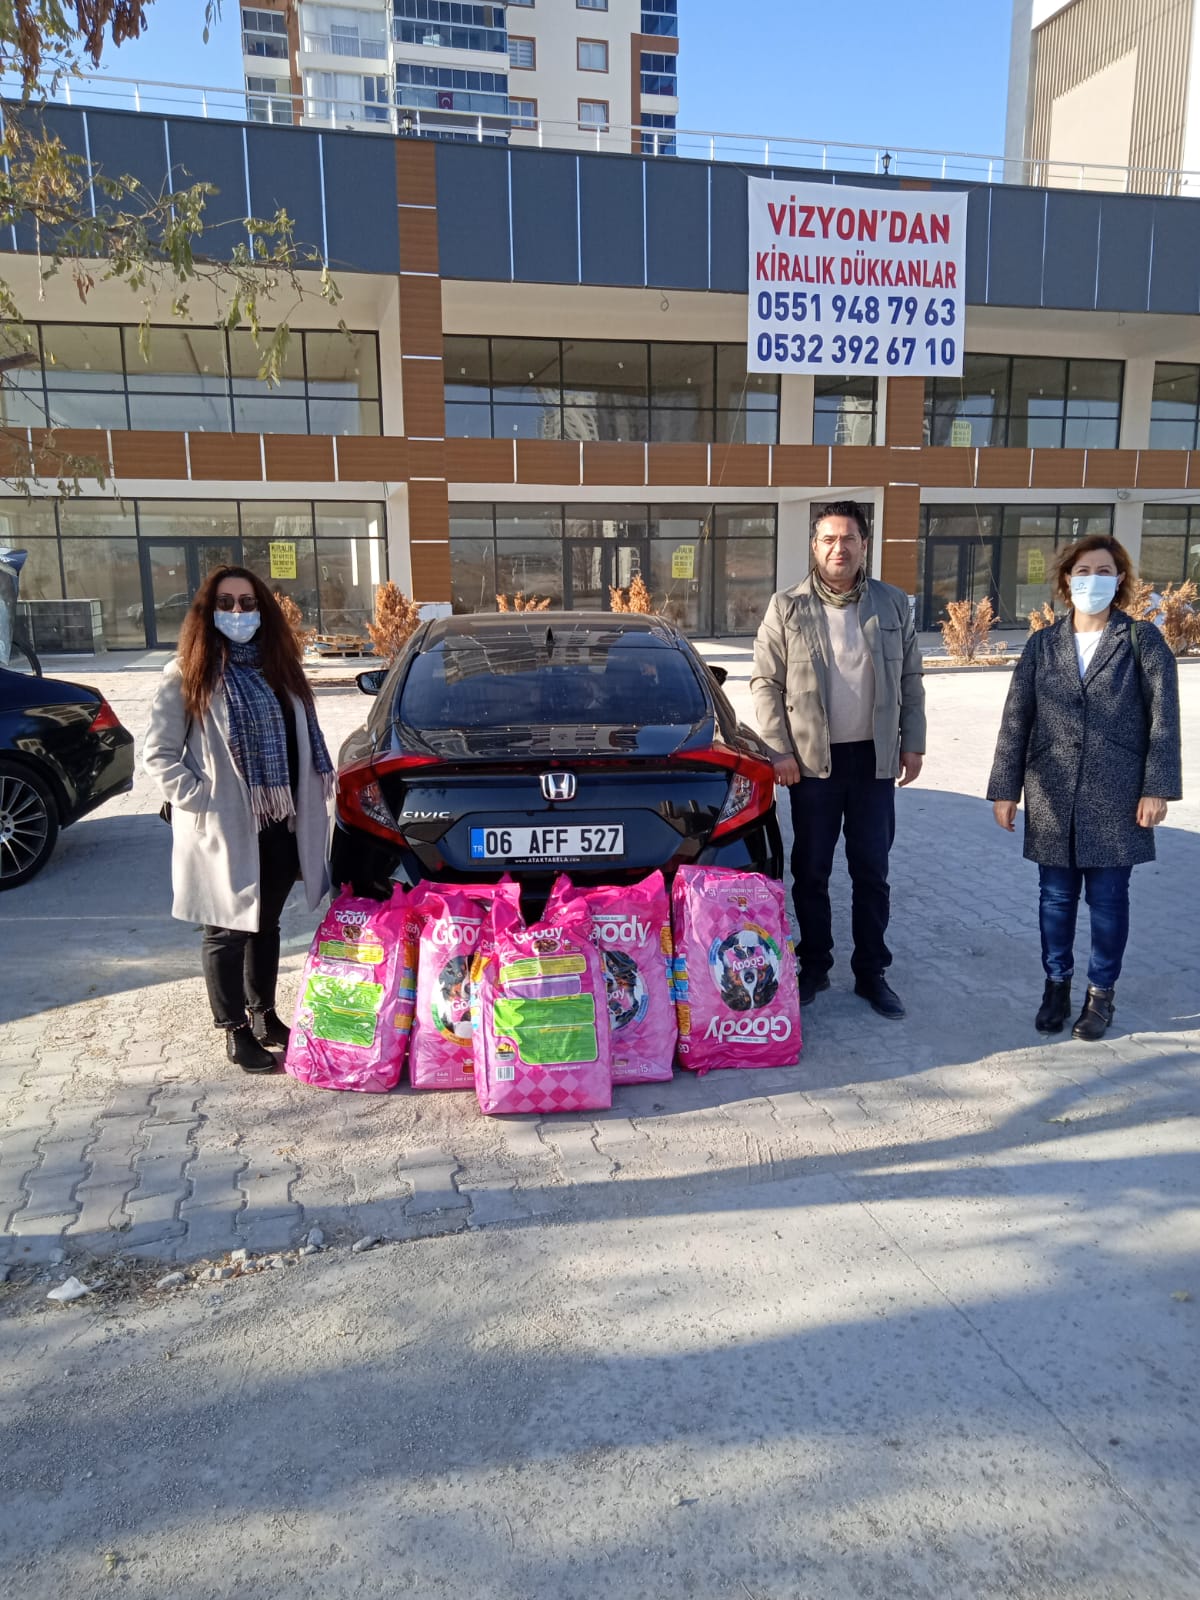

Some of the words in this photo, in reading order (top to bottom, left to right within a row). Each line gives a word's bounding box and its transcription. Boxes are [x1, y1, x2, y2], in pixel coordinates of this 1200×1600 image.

[767, 195, 950, 244] VİZYON'DAN
[756, 243, 835, 285] KİRALIK
[840, 250, 957, 289] DÜKKANLAR
[757, 291, 821, 322] 0551
[831, 294, 880, 324] 948
[887, 296, 918, 325] 79
[924, 298, 956, 326] 63
[757, 332, 823, 363] 0532
[831, 334, 879, 364] 392
[886, 337, 917, 366] 67
[925, 337, 956, 366] 10
[402, 811, 450, 819] CIVIC
[472, 845, 484, 853] TR
[486, 830, 513, 855] 06
[529, 829, 569, 854] AFF
[580, 828, 620, 852] 527
[432, 918, 480, 946] Goo
[704, 1015, 792, 1044] Goody
